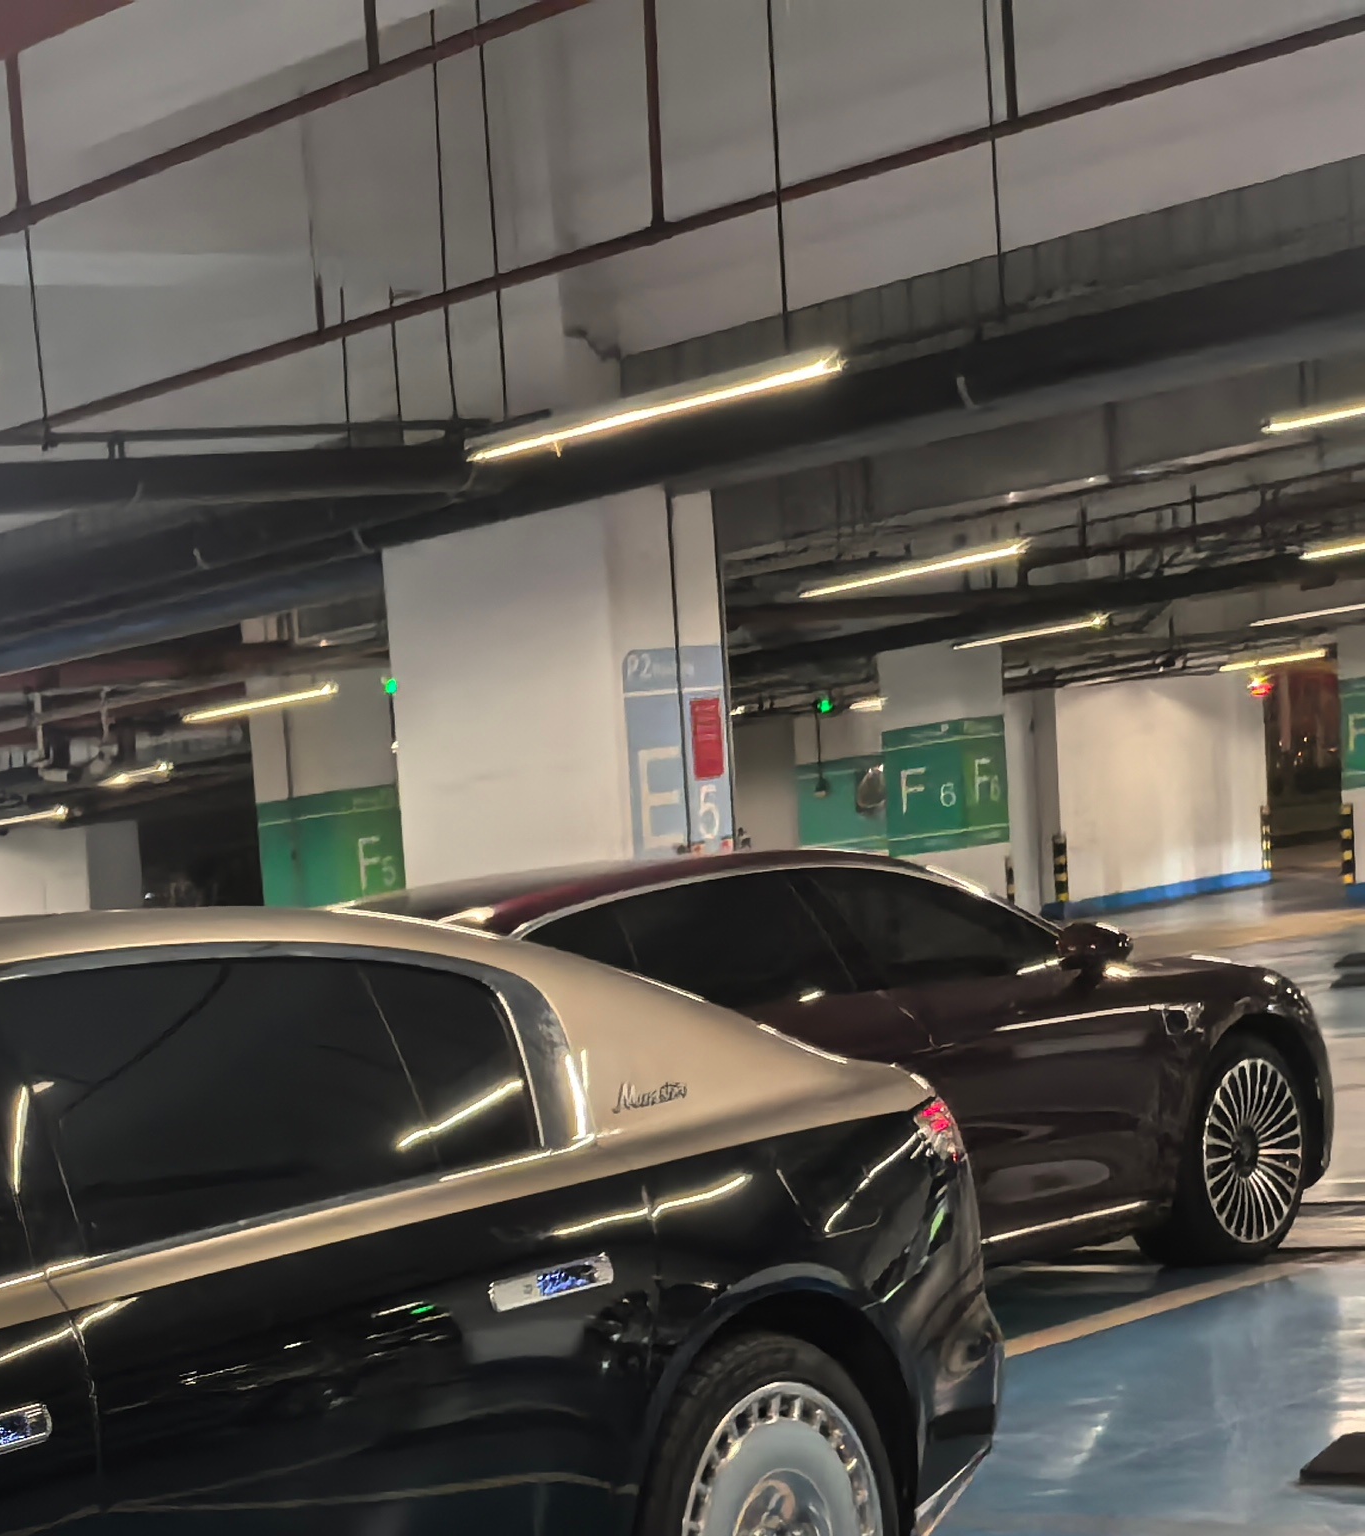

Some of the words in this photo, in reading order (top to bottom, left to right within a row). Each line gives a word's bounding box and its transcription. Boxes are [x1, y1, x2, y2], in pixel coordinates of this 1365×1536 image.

[638, 746, 686, 849] E
[698, 783, 719, 838] 5
[900, 766, 927, 814] F
[939, 782, 957, 807] 6
